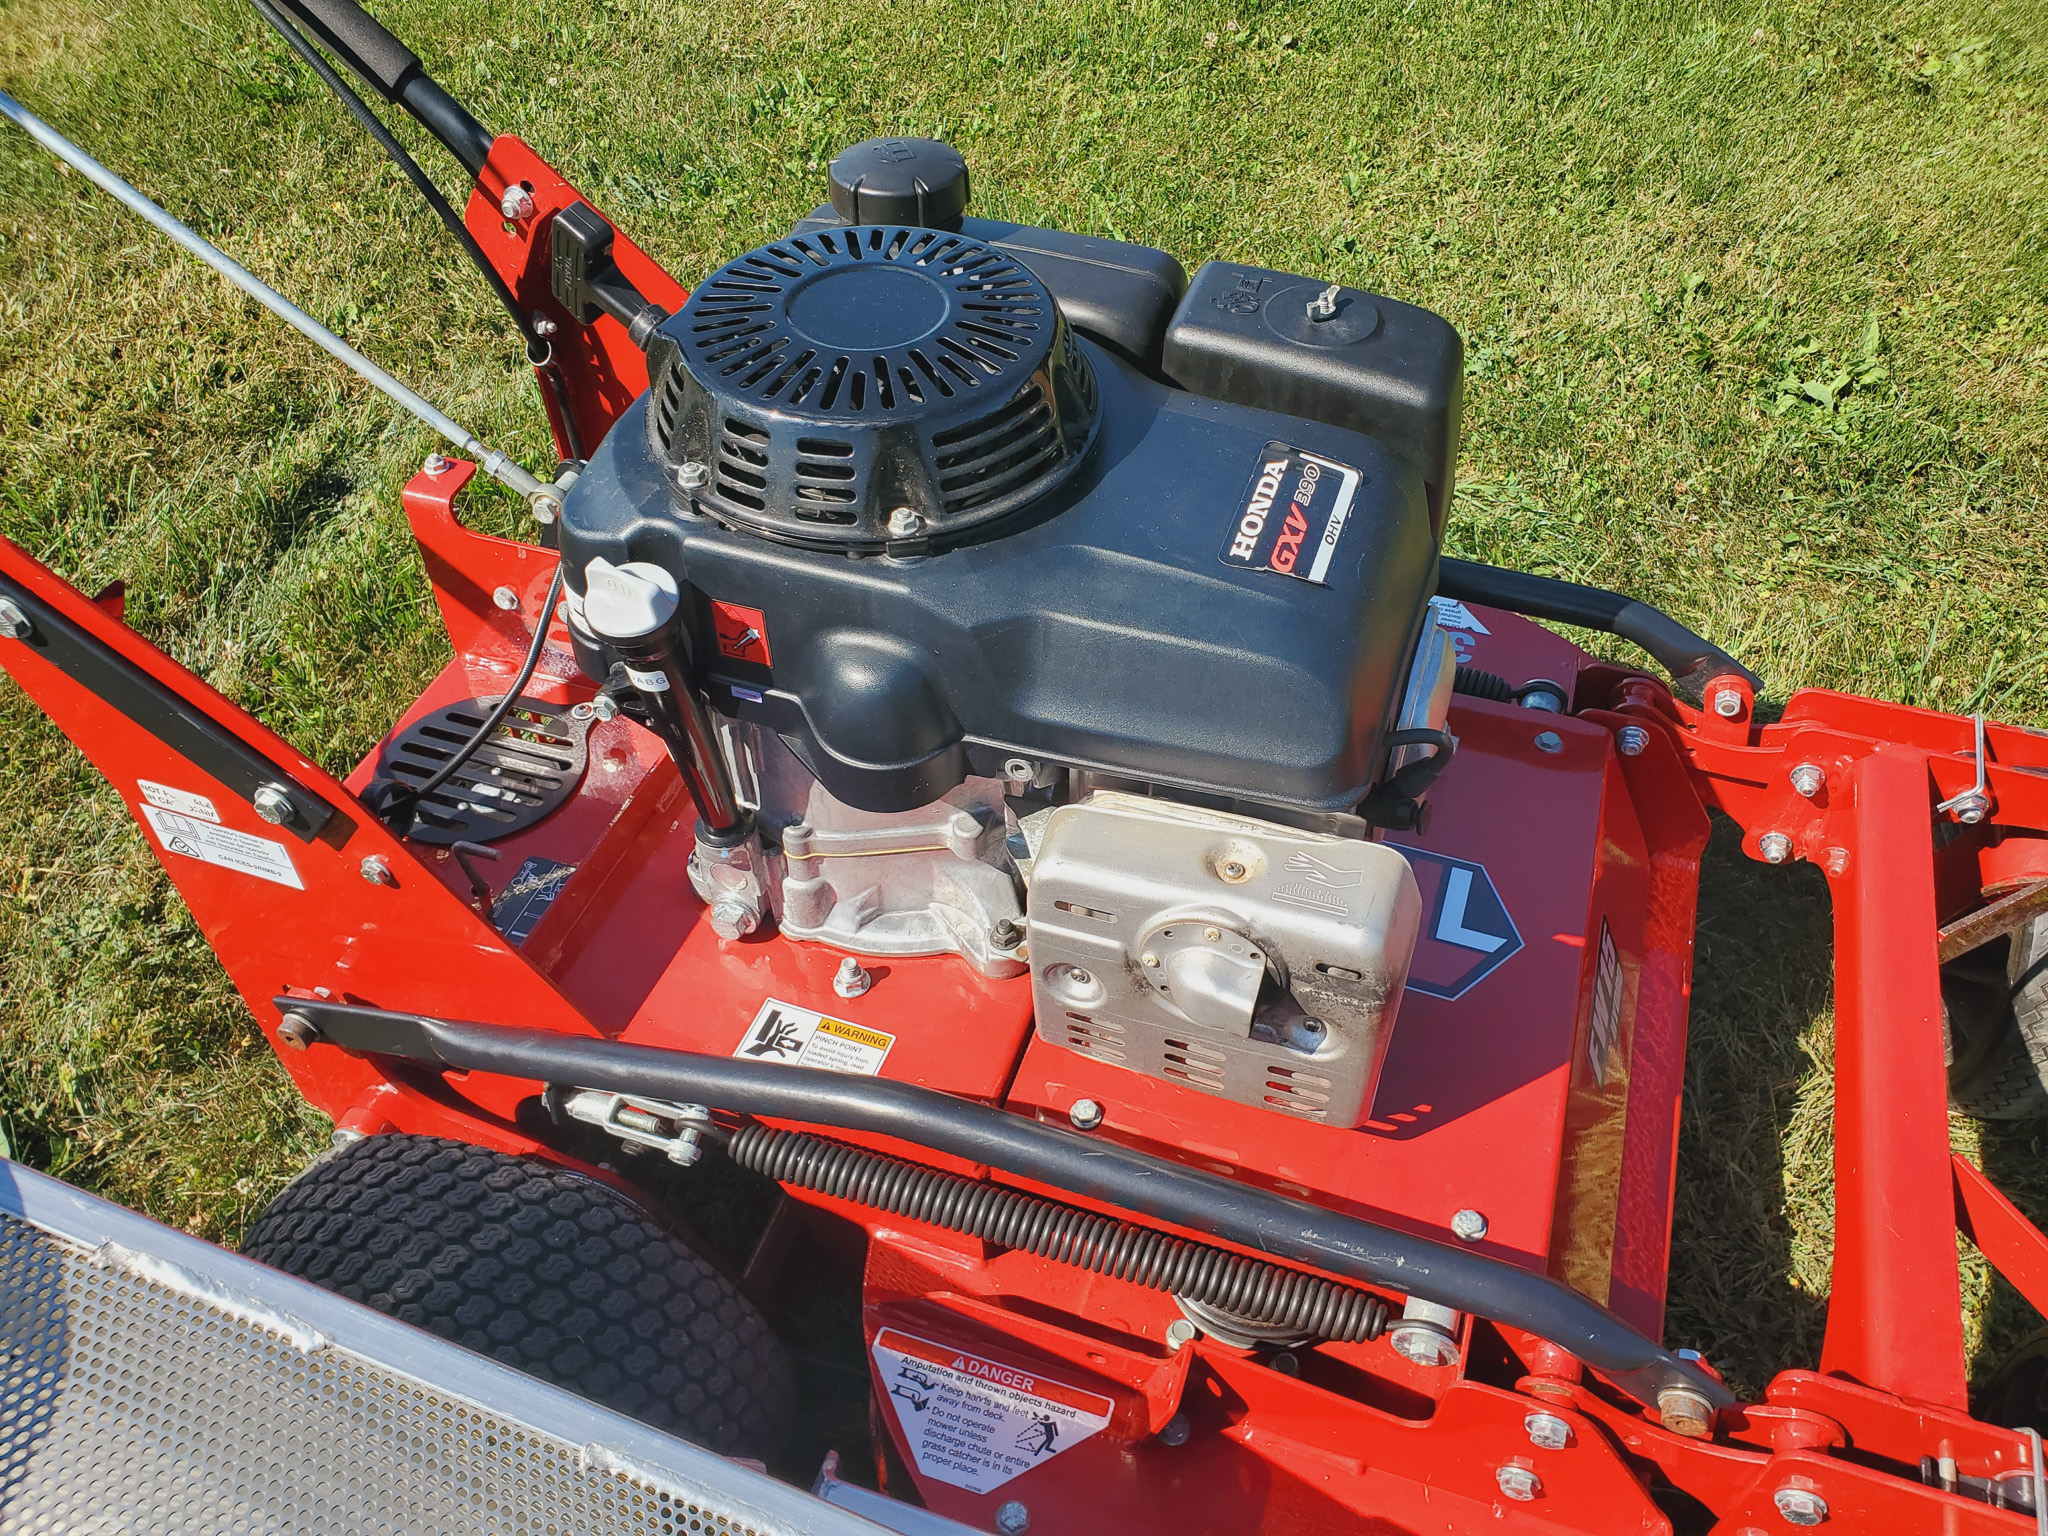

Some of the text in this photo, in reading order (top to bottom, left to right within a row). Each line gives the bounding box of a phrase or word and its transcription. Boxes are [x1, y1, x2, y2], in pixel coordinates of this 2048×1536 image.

[1229, 459, 1289, 561] HONDA
[1270, 463, 1321, 573] GXV 390
[1324, 514, 1342, 547] OHV
[140, 784, 161, 795] NOT
[145, 793, 157, 801] IN
[815, 1034, 863, 1054] PINCH POINT
[834, 1023, 887, 1047] WARNING
[803, 1056, 834, 1068] operator's
[807, 1049, 828, 1059] loaded
[850, 1063, 865, 1071] read
[819, 1045, 837, 1054] avoid
[837, 1051, 854, 1061] injury
[854, 1056, 870, 1065] from
[901, 1356, 1077, 1418] Amputation and thrown objects hazard
[967, 1360, 1035, 1392] DANGER
[936, 1394, 960, 1409] away
[961, 1400, 981, 1413] from
[941, 1382, 1029, 1418] Keep hands and feet
[927, 1418, 988, 1443] mower unless
[931, 1405, 996, 1434] Do not operate
[921, 1439, 1014, 1475] grass catcher is in its
[923, 1427, 1031, 1469] discharge chute or entire
[922, 1451, 979, 1476] proper place.
